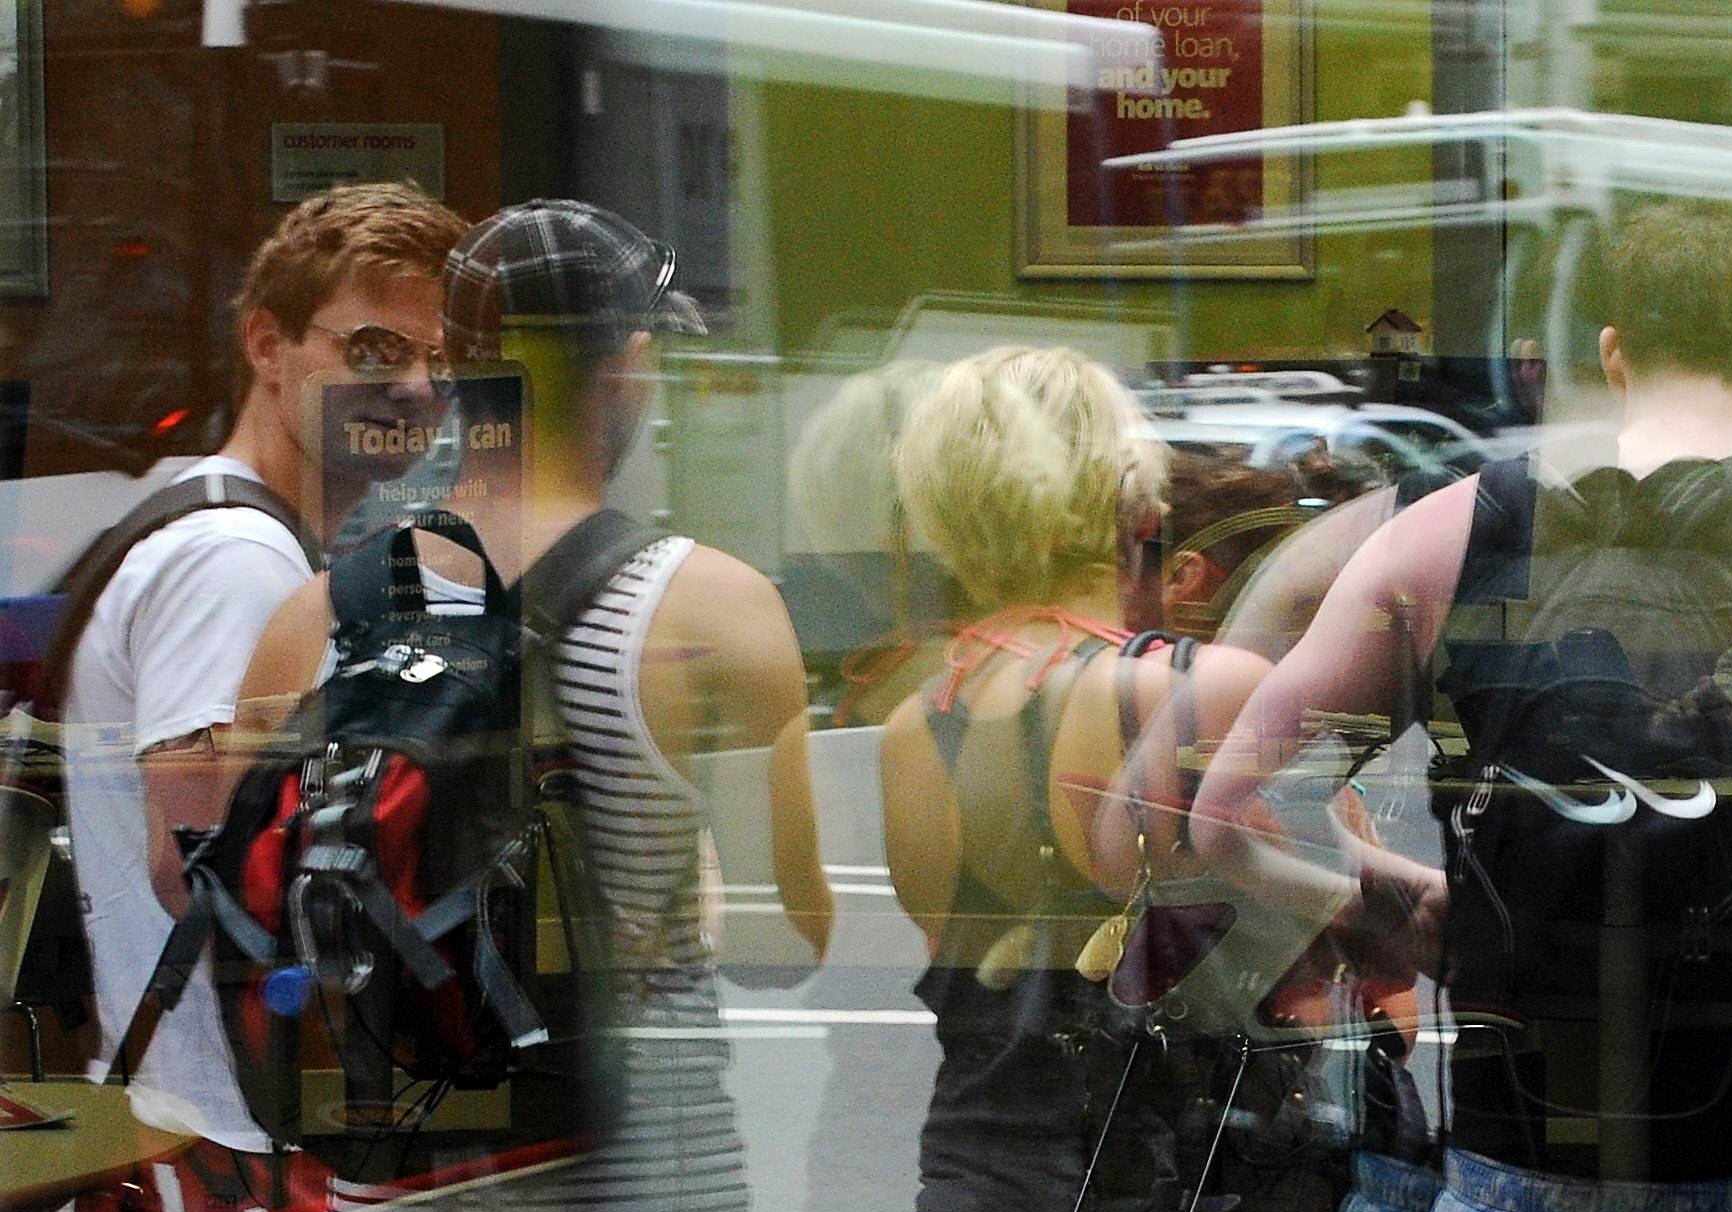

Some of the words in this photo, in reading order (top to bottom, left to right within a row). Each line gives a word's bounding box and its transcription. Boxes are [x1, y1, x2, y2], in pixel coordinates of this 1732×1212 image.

[1116, 0, 1145, 22] of
[1151, 6, 1213, 27] your
[1090, 29, 1166, 58] home
[1175, 29, 1240, 62] loan,
[1099, 61, 1156, 89] and
[1160, 66, 1232, 96] your
[1116, 91, 1211, 119] home.
[284, 133, 360, 149] customer
[363, 135, 416, 149] rooms
[343, 418, 442, 461] Today
[468, 422, 512, 450] can
[379, 480, 417, 504] help
[422, 482, 450, 502] you
[453, 479, 489, 499] with
